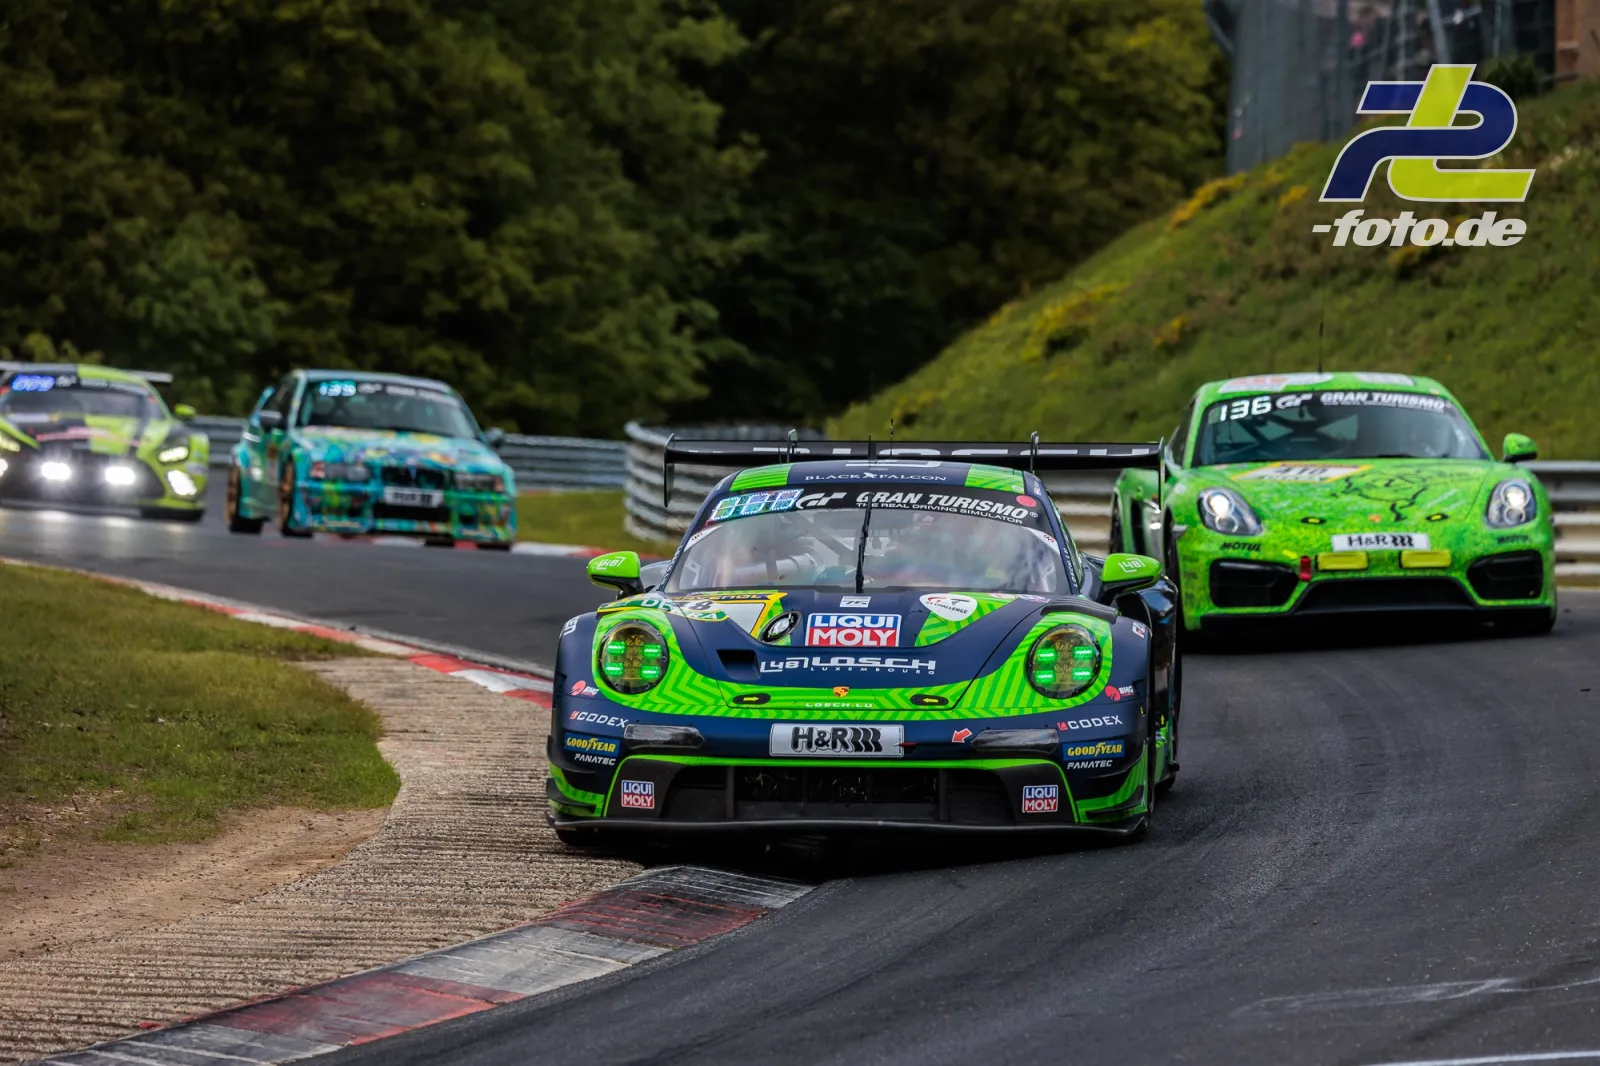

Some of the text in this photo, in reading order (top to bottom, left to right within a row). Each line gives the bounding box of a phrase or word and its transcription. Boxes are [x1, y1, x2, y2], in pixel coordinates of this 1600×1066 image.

[1320, 391, 1369, 404] GRAN
[1371, 393, 1446, 409] TURISMO
[1219, 396, 1272, 422] 136
[805, 473, 947, 482] BLACK FALCON
[856, 491, 924, 504] GRAN
[912, 503, 958, 513] DRIVING
[959, 508, 1024, 525] SIMULATOR
[1220, 542, 1261, 552] MOTUL
[934, 602, 968, 615] CHALLENGE
[814, 615, 896, 630] LIQUI
[812, 629, 897, 646] MOLY
[811, 656, 937, 671] LOSCH
[576, 711, 629, 728] CODEX
[1067, 715, 1124, 730] CODEX
[566, 736, 616, 753] GOODYEAR
[1066, 742, 1124, 758] GOODYEAR
[573, 753, 616, 766] FANATEC
[1066, 759, 1113, 770] FANATEC
[623, 781, 653, 795] LIQUI
[1025, 786, 1058, 799] LIQUI
[622, 794, 654, 808] MOLY
[1024, 799, 1058, 812] MOLY
